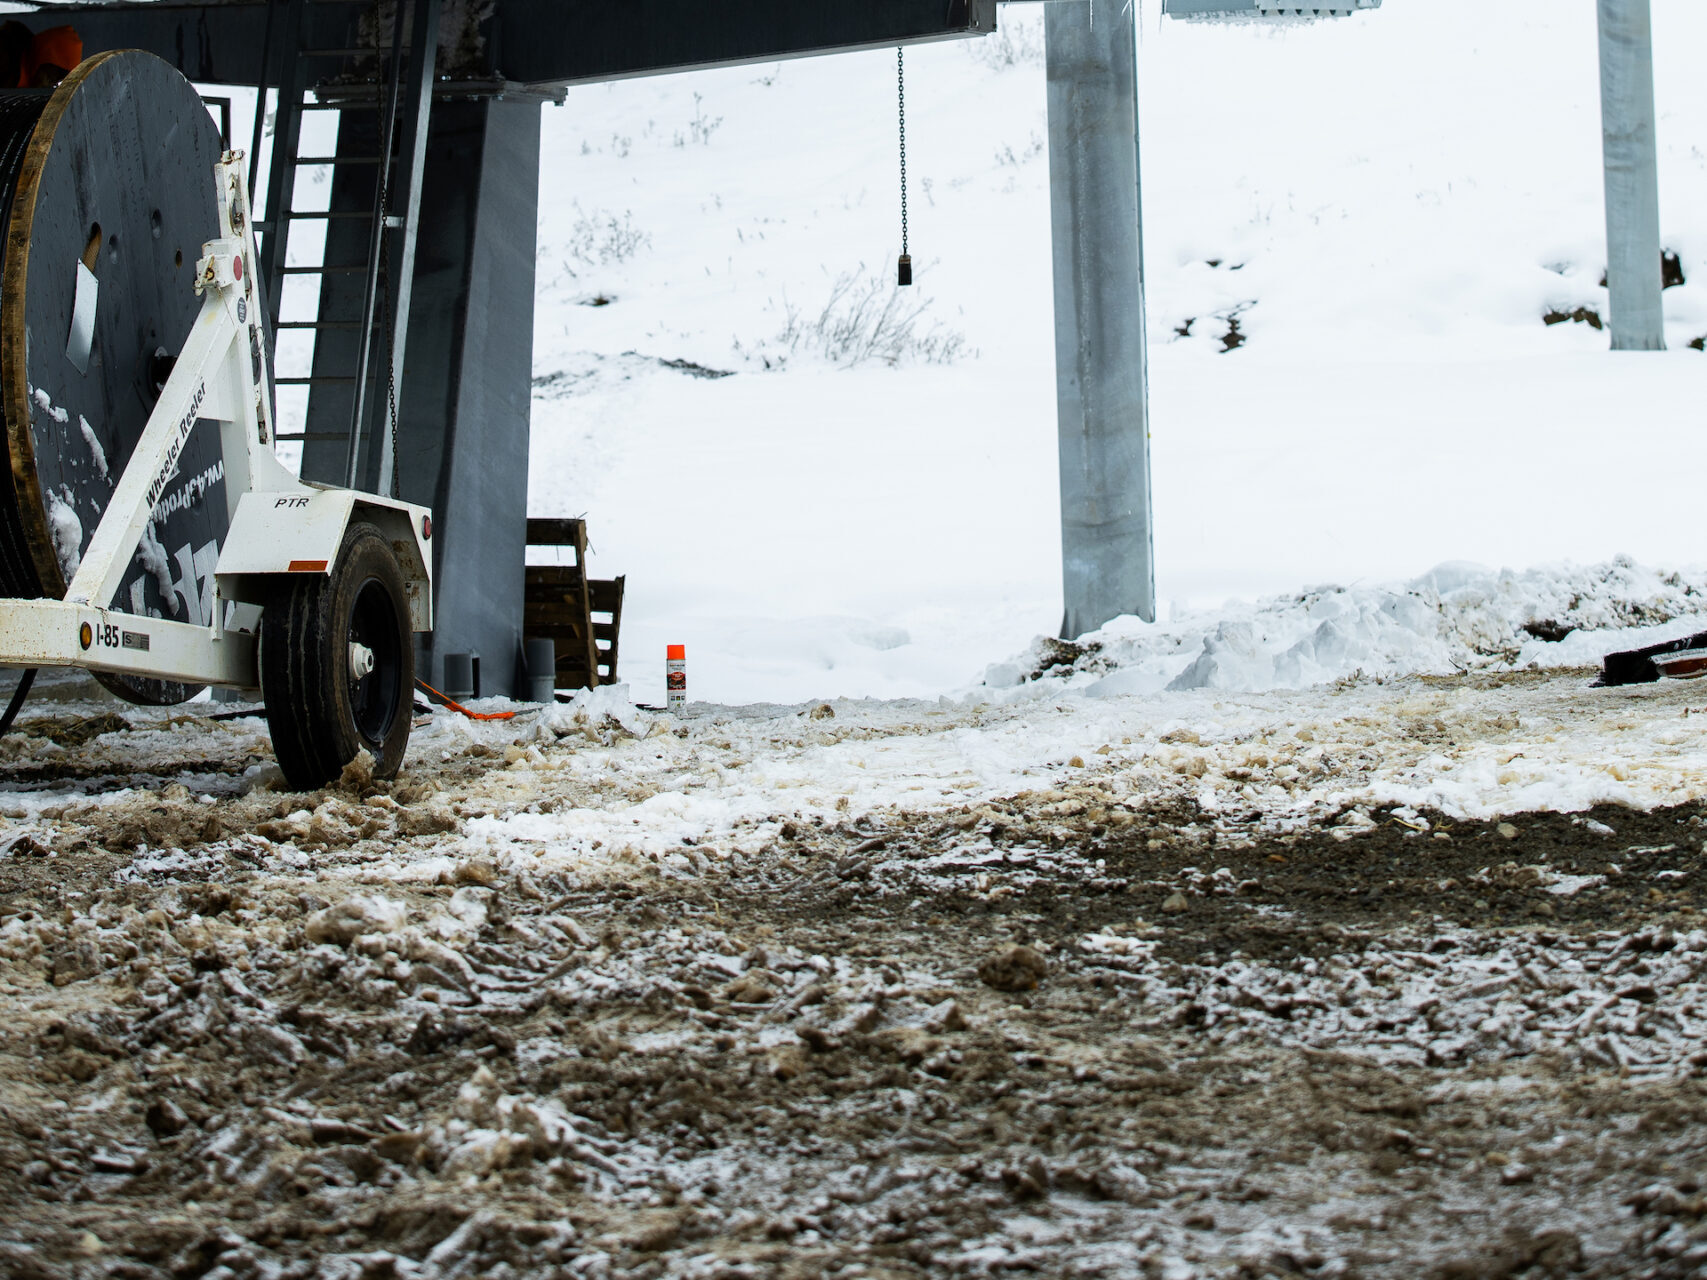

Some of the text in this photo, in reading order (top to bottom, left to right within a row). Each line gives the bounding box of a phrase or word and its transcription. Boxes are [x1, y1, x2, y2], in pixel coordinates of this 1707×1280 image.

[146, 382, 206, 509] Wheeler Reeler
[274, 498, 309, 508] PTR
[97, 623, 119, 648] I-85
